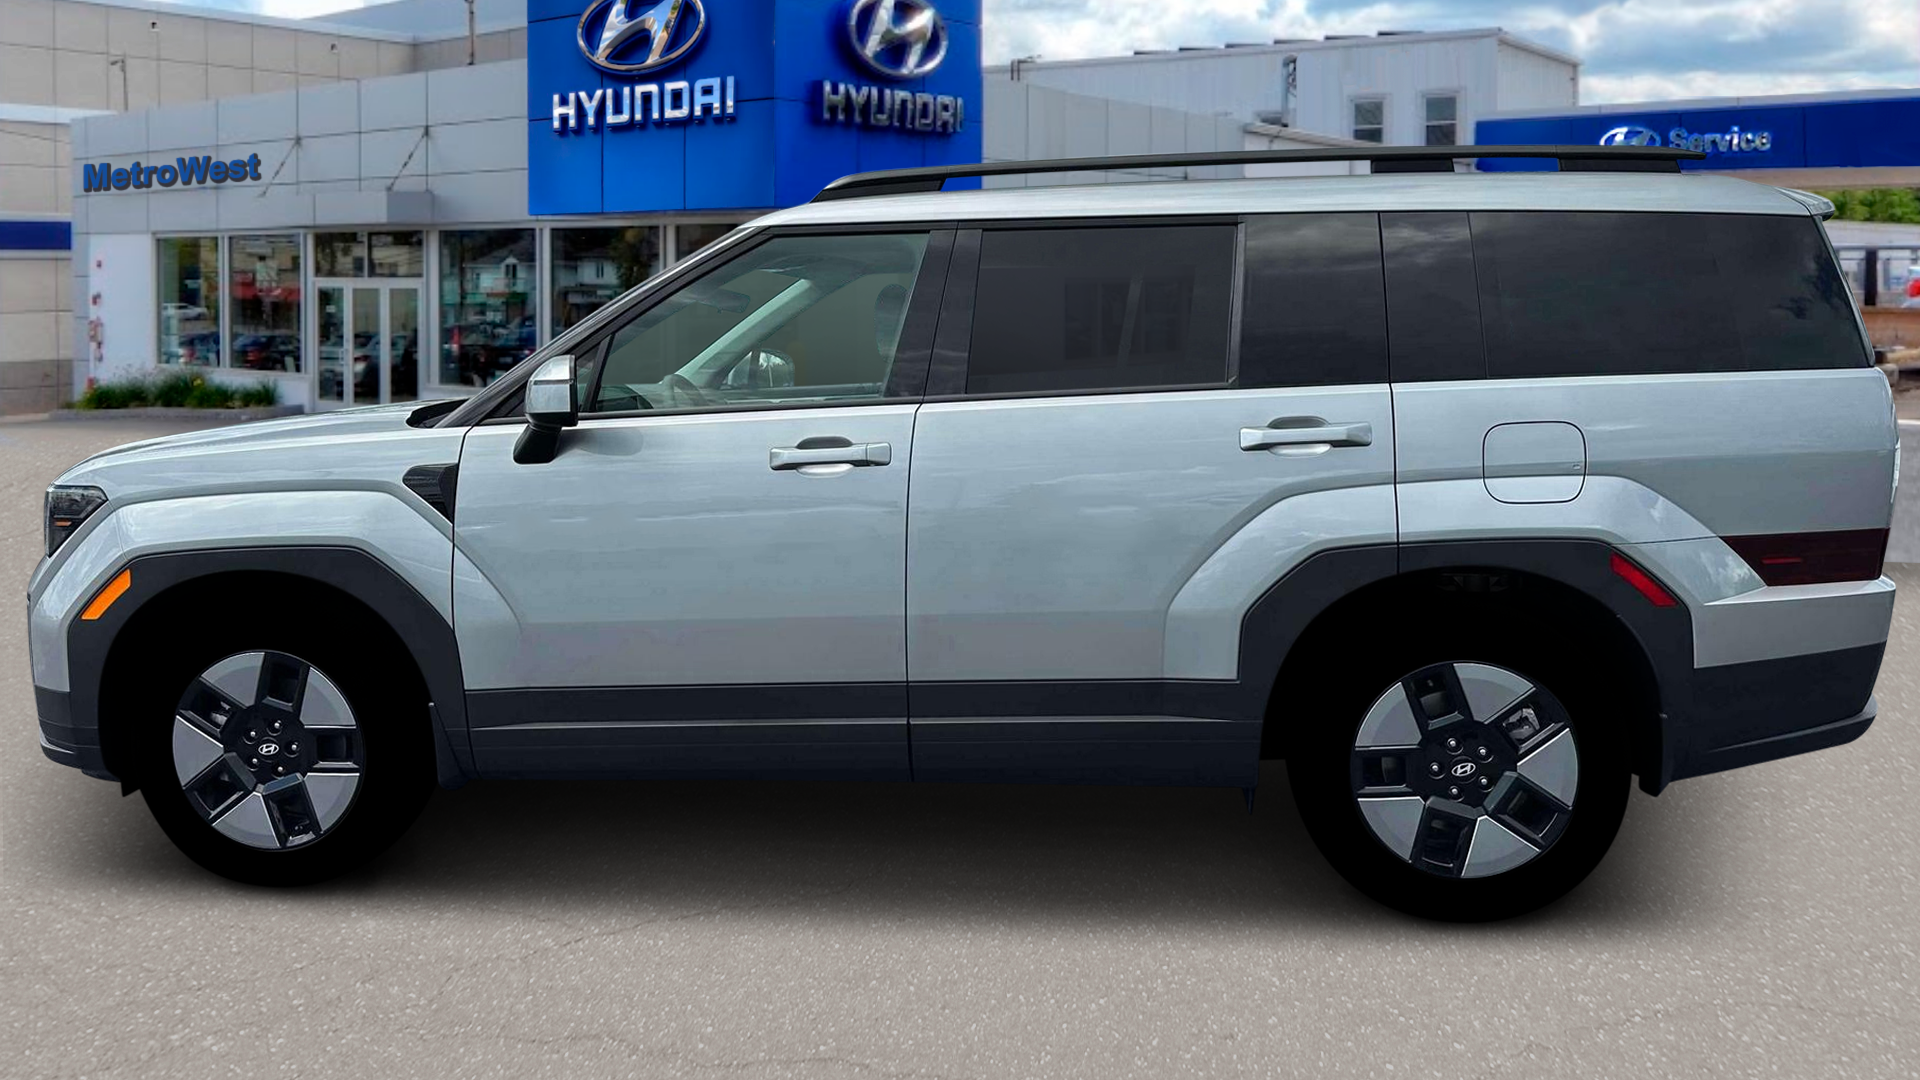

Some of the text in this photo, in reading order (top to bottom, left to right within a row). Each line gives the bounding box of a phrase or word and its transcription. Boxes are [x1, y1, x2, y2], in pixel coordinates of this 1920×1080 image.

[552, 76, 735, 130] HYUNDAI
[822, 80, 965, 133] HYUNDAI
[1669, 125, 1772, 153] Service
[83, 153, 262, 193] MetroWest
